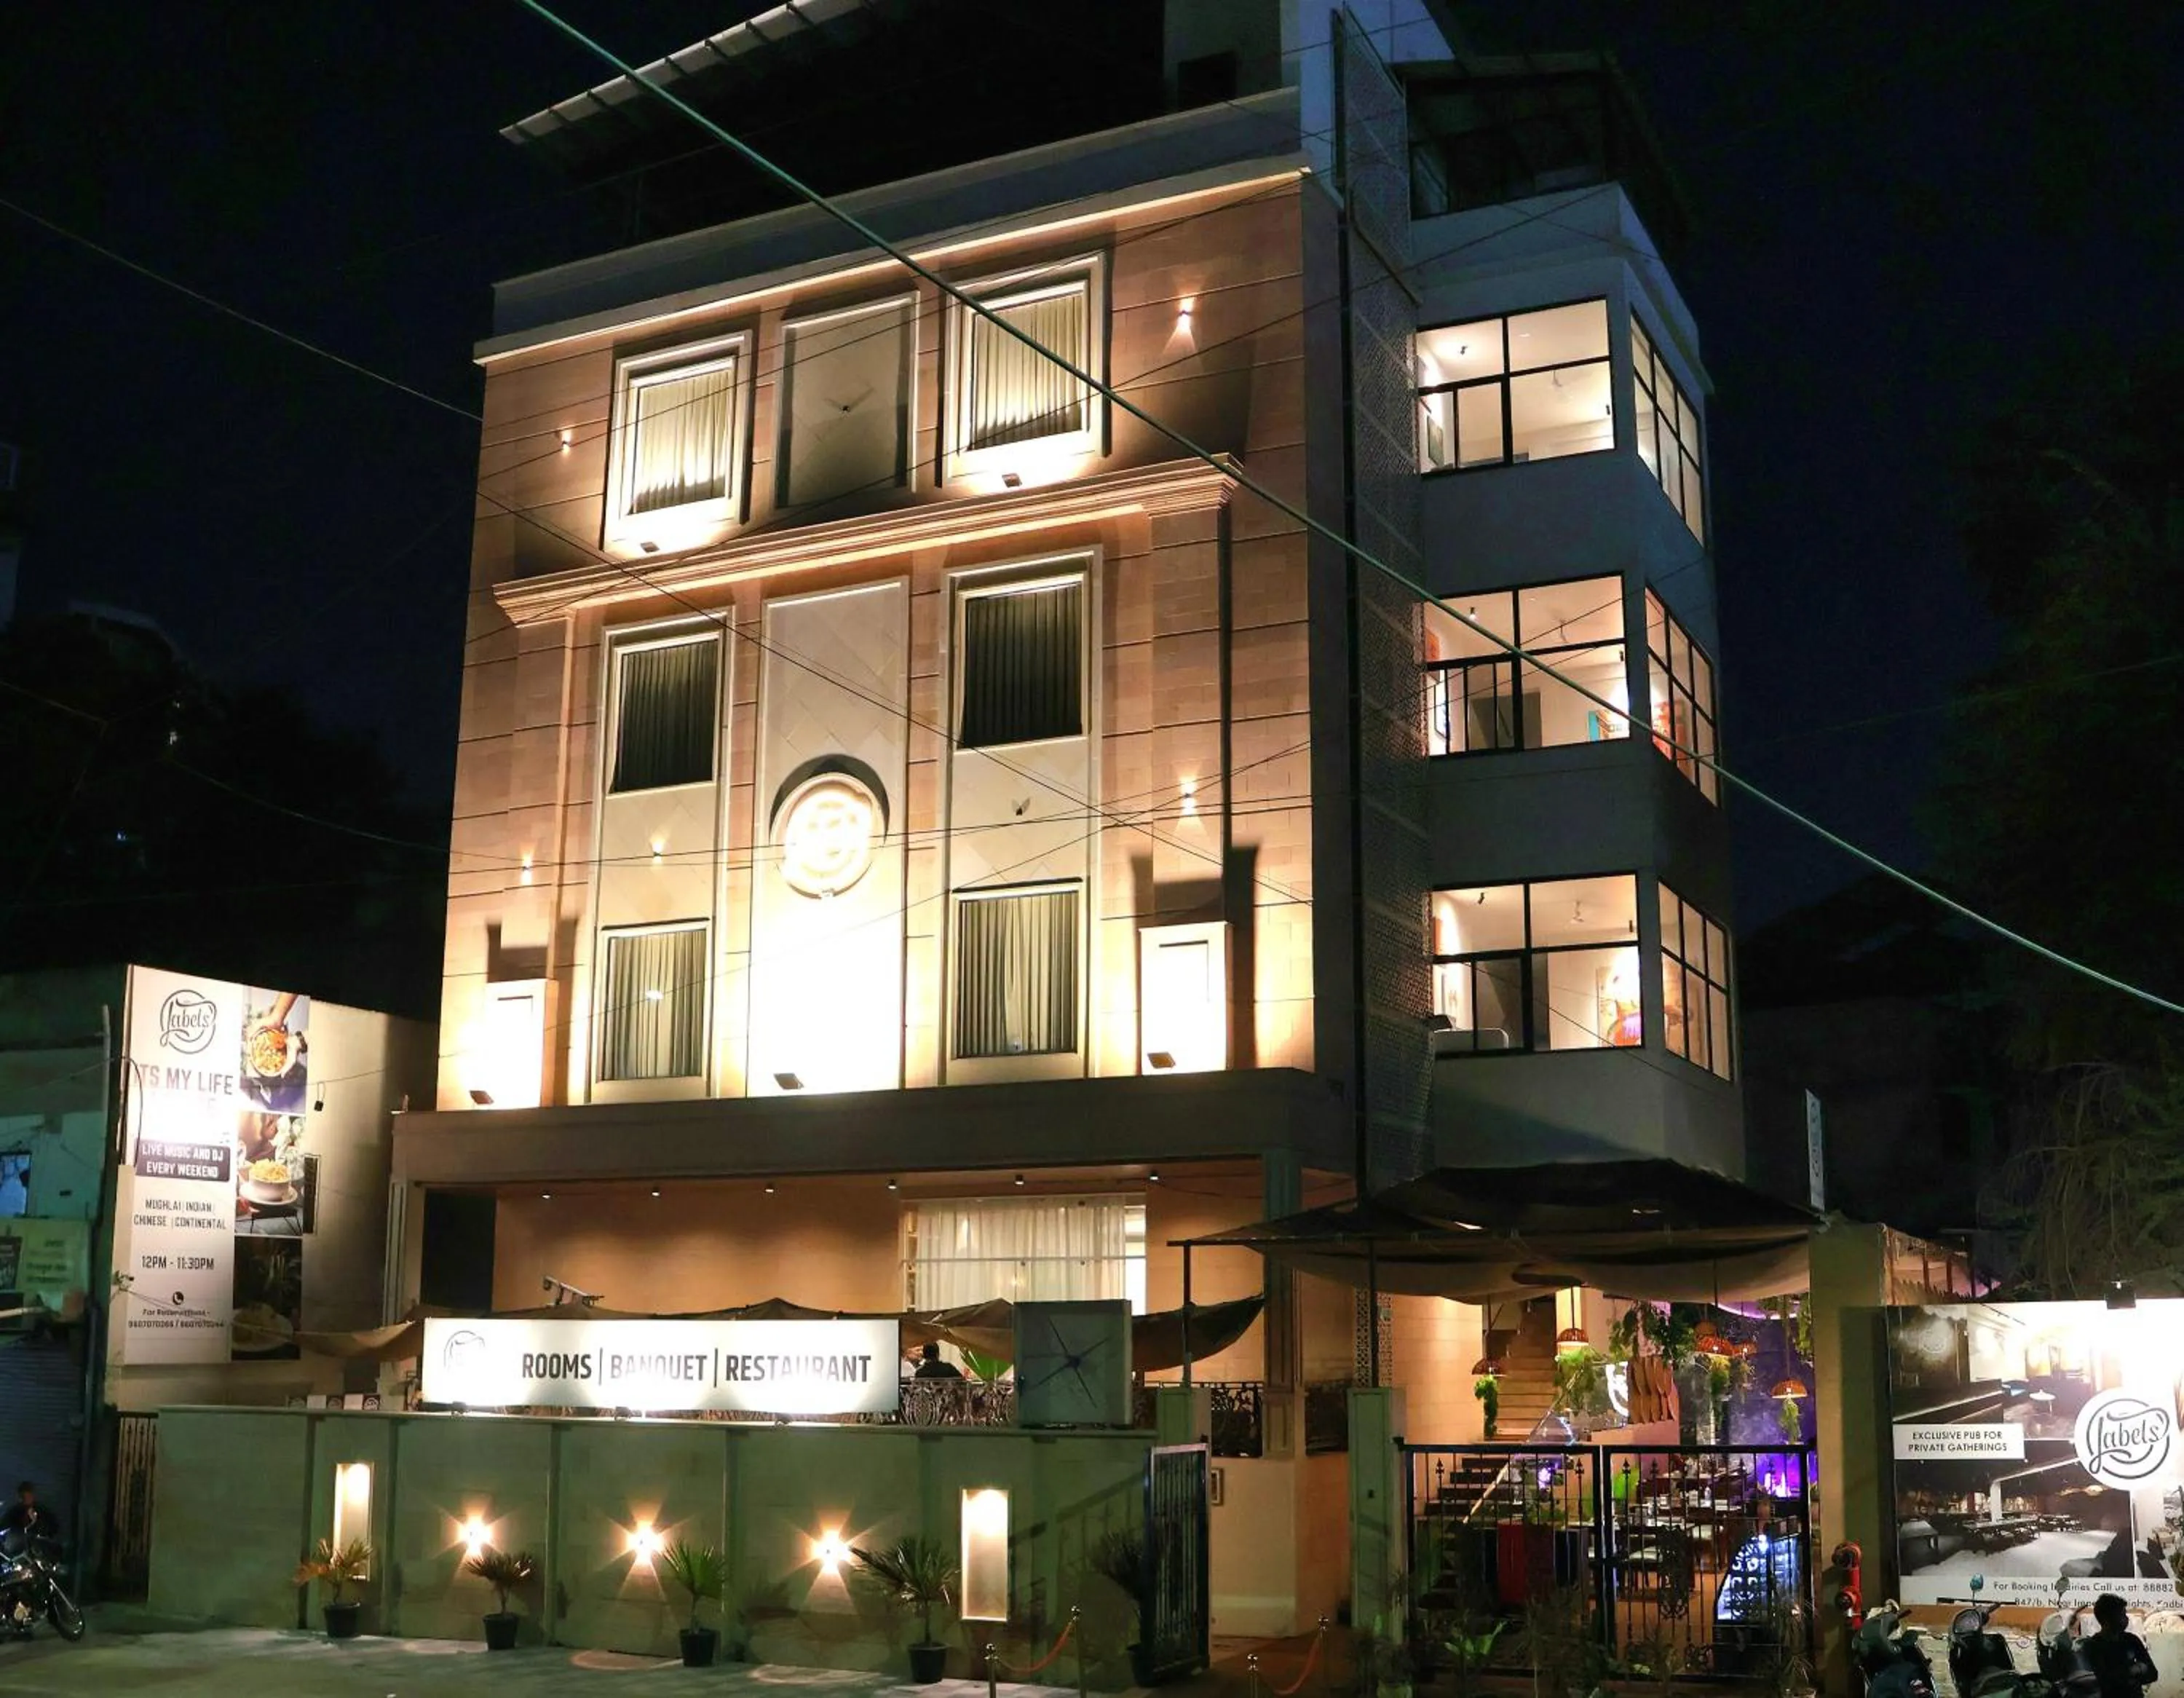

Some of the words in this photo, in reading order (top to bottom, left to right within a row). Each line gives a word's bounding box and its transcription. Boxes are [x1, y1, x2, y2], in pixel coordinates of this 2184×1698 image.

[166, 1067, 191, 1090] MY
[198, 1071, 234, 1095] LIFE
[142, 1143, 163, 1156] LIVE
[193, 1147, 210, 1160] AND
[212, 1148, 223, 1161] DJ
[146, 1161, 175, 1174] EVERY
[177, 1164, 218, 1177] WEEKEND
[145, 1199, 181, 1211] MUGHLAI
[186, 1201, 212, 1212] INDIAN
[134, 1215, 167, 1227] CHINESE
[175, 1217, 226, 1230] CONTINENTAL
[142, 1256, 167, 1269] 12PM
[177, 1257, 215, 1270] 11:30PM
[521, 1353, 592, 1379] ROOMS
[610, 1354, 708, 1381] BANQUET
[726, 1354, 871, 1382] RESTAURANT
[1912, 1431, 1961, 1440] EXCLUSIVE
[1964, 1431, 1981, 1440] PUB
[1984, 1431, 2003, 1440] FOR
[1908, 1443, 1944, 1452] PRIVATE
[1947, 1442, 2007, 1452] GATHERINGS
[1994, 1581, 2009, 1590] For
[2011, 1581, 2048, 1593] Booking
[2093, 1581, 2112, 1592] Call
[2115, 1584, 2125, 1592] us
[2143, 1582, 2174, 1592] 88882
